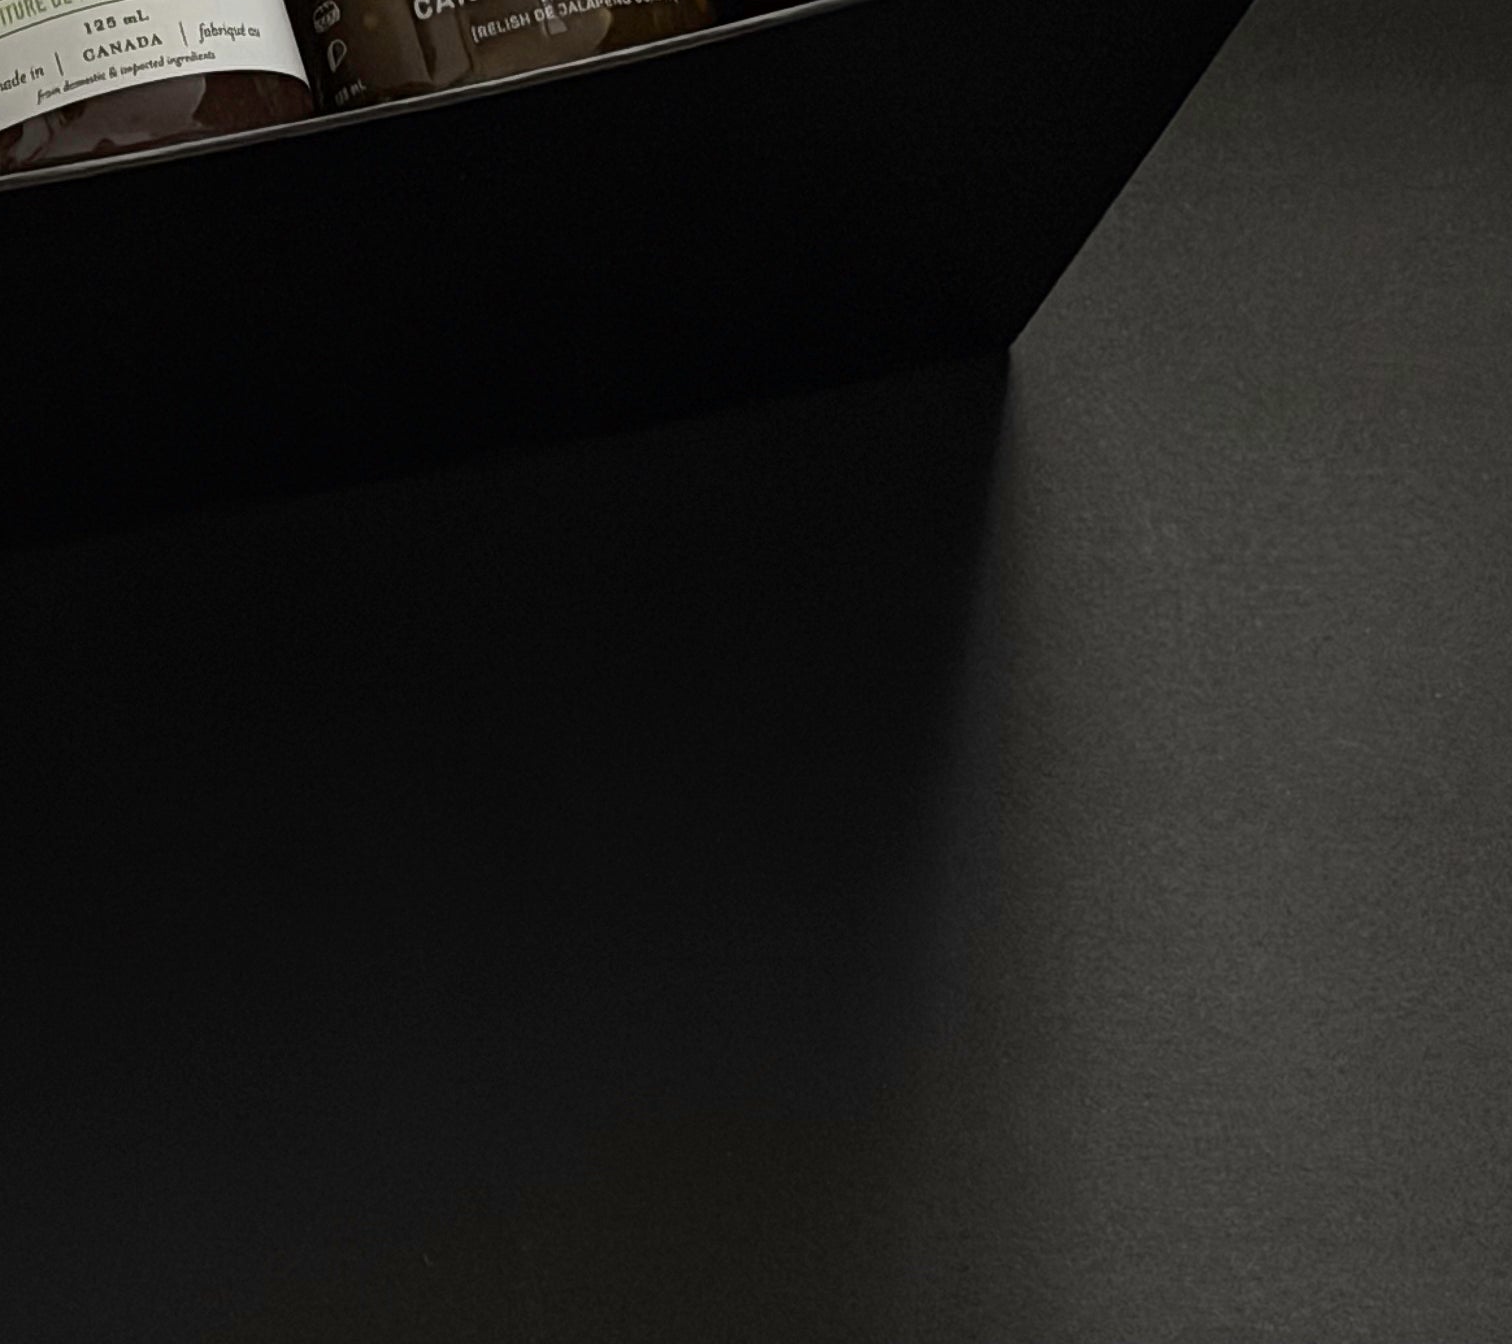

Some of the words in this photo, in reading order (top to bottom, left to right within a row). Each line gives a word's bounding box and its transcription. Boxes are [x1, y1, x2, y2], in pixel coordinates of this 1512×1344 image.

[535, 4, 554, 22] DE
[84, 16, 116, 35] 125
[83, 33, 163, 62] CANADA
[30, 65, 44, 82] in
